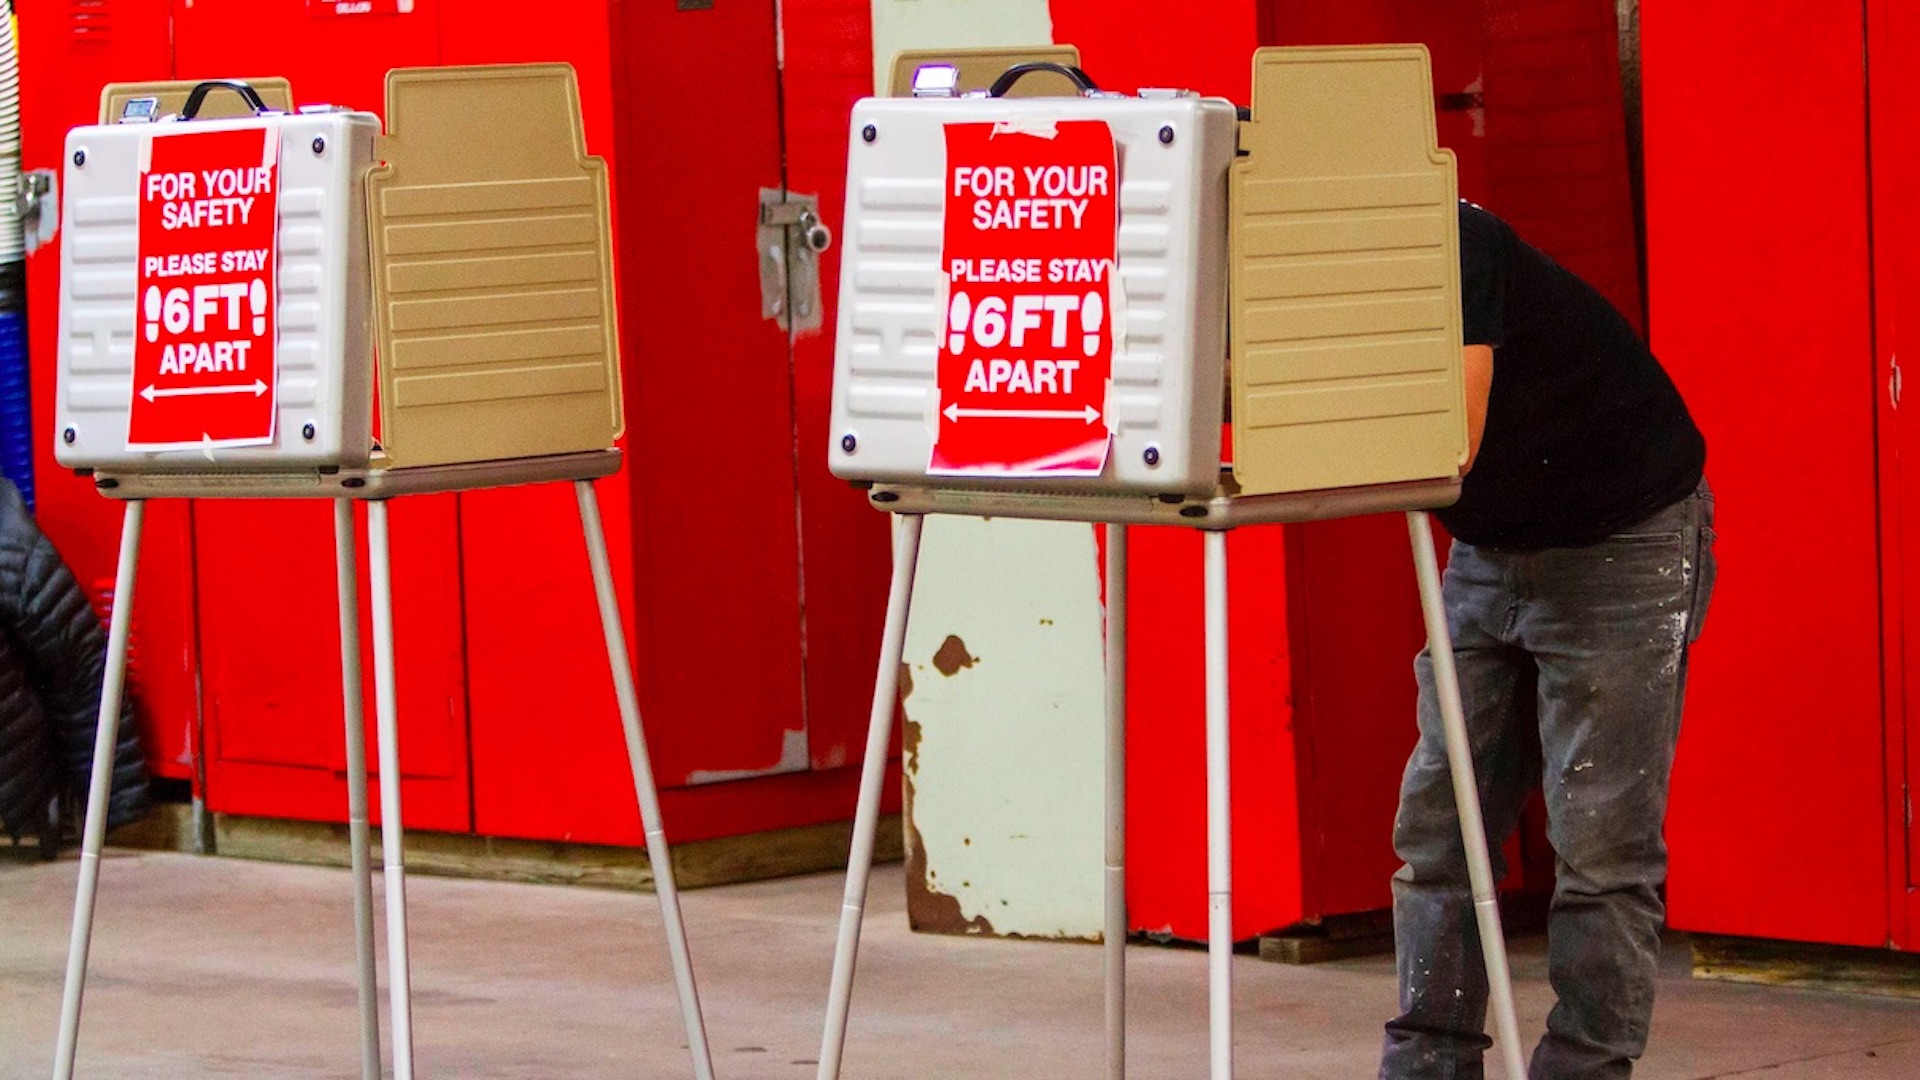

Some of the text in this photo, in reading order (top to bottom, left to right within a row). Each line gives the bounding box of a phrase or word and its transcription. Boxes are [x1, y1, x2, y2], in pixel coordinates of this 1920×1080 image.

[147, 167, 271, 201] FOR YOUR
[954, 165, 1108, 197] FOR YOUR
[161, 197, 254, 230] SAFETY
[972, 198, 1089, 230] SAFETY
[145, 248, 269, 277] PLEASE STAY
[951, 258, 1106, 283] PLEASE STAY
[163, 282, 249, 334] 6FT
[972, 294, 1080, 348] 6FT
[159, 339, 252, 375] APART
[964, 359, 1080, 394] APART
